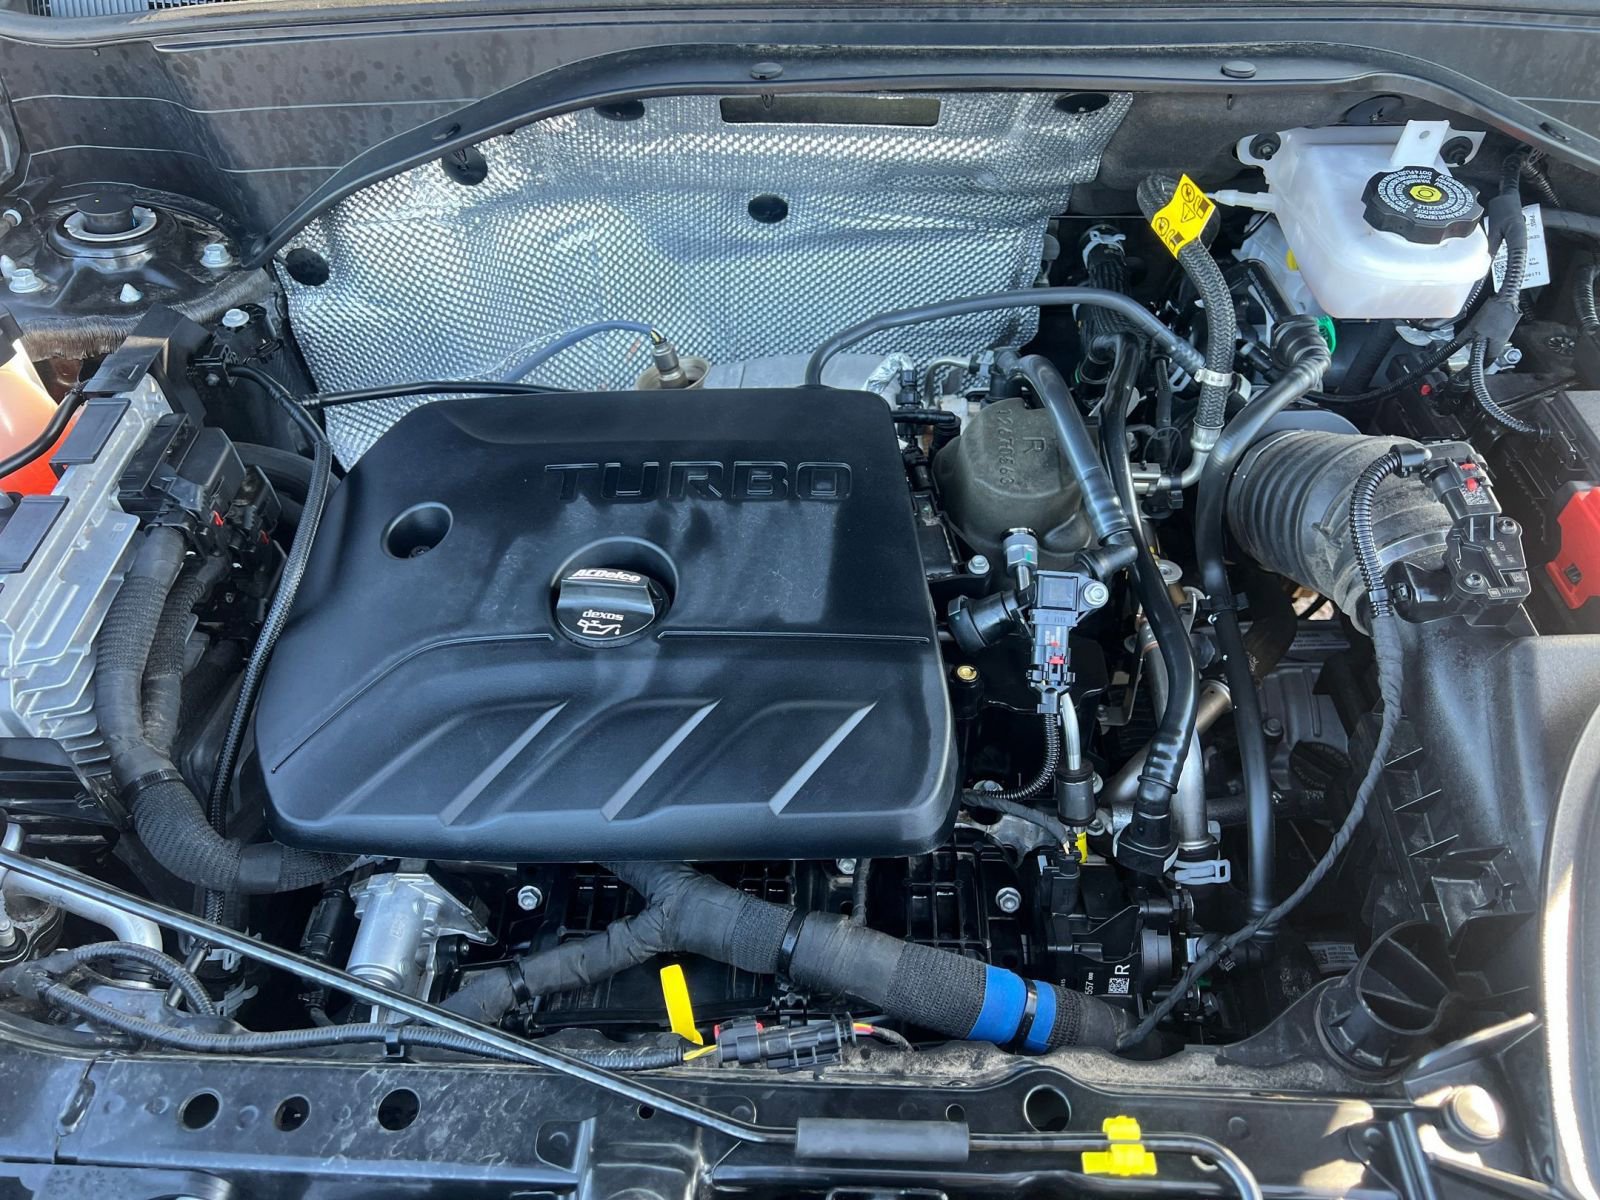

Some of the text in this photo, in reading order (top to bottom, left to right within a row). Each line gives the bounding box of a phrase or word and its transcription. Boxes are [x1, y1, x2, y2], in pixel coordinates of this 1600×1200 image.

[1023, 436, 1047, 453] R
[544, 461, 851, 502] TURBO
[572, 569, 641, 582] ACDelco
[582, 609, 624, 621] dexos
[1114, 964, 1131, 975] R
